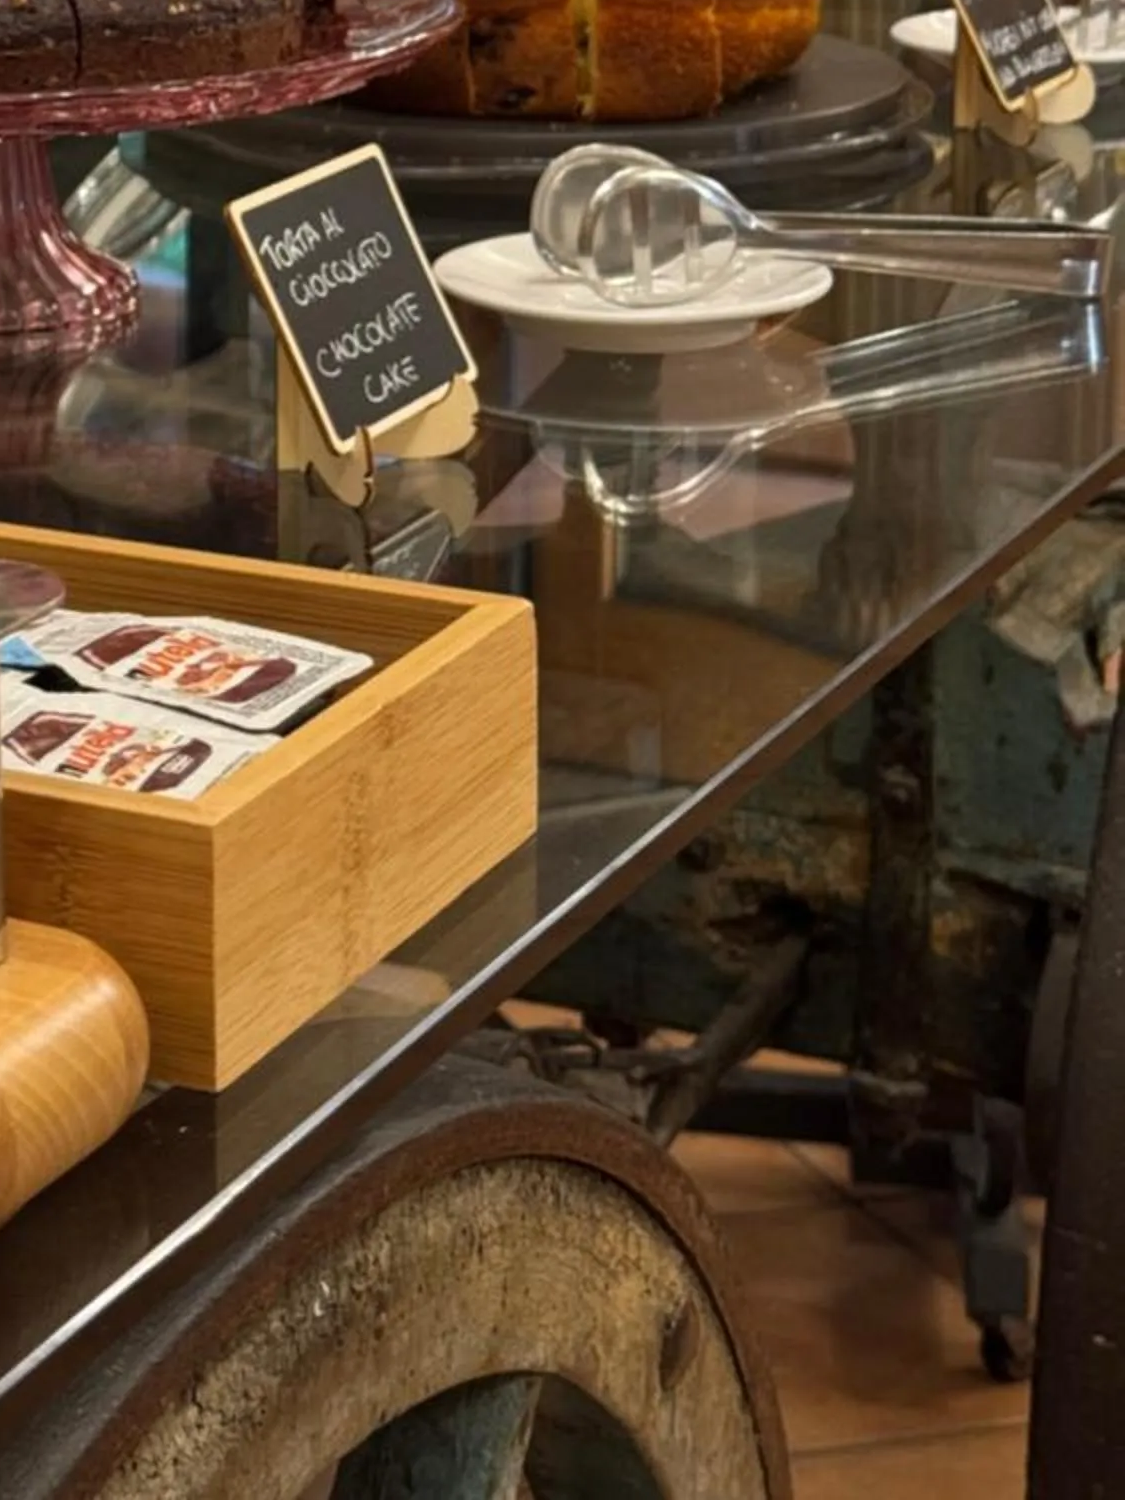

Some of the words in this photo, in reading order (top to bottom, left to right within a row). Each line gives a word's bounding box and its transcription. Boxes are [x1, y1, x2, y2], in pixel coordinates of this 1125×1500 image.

[258, 221, 321, 271] TORTA
[316, 291, 422, 378] CHOCOLATE
[363, 355, 420, 404] CAKE
